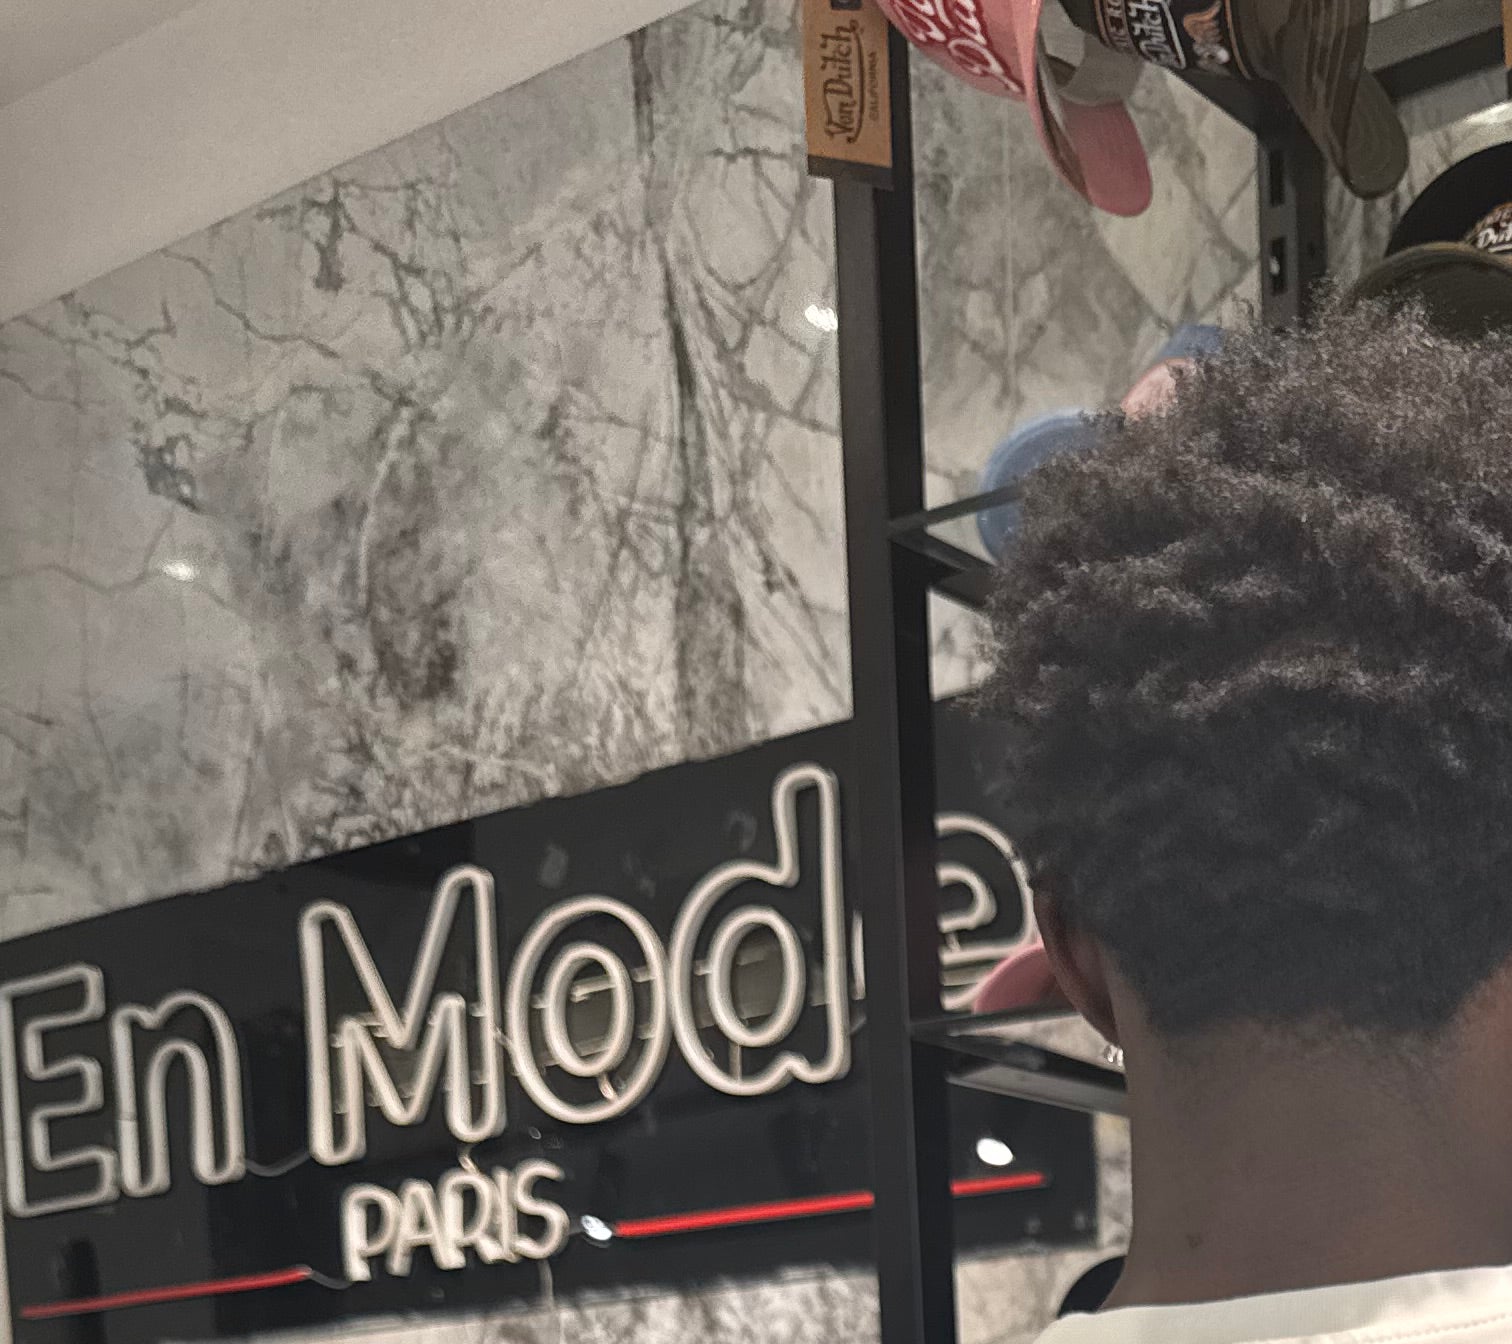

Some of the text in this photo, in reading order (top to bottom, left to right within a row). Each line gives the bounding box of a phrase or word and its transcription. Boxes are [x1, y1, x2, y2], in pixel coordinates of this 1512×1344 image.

[819, 19, 859, 98] Dutch
[0, 962, 246, 1218] En
[341, 1162, 571, 1283] PARIS
